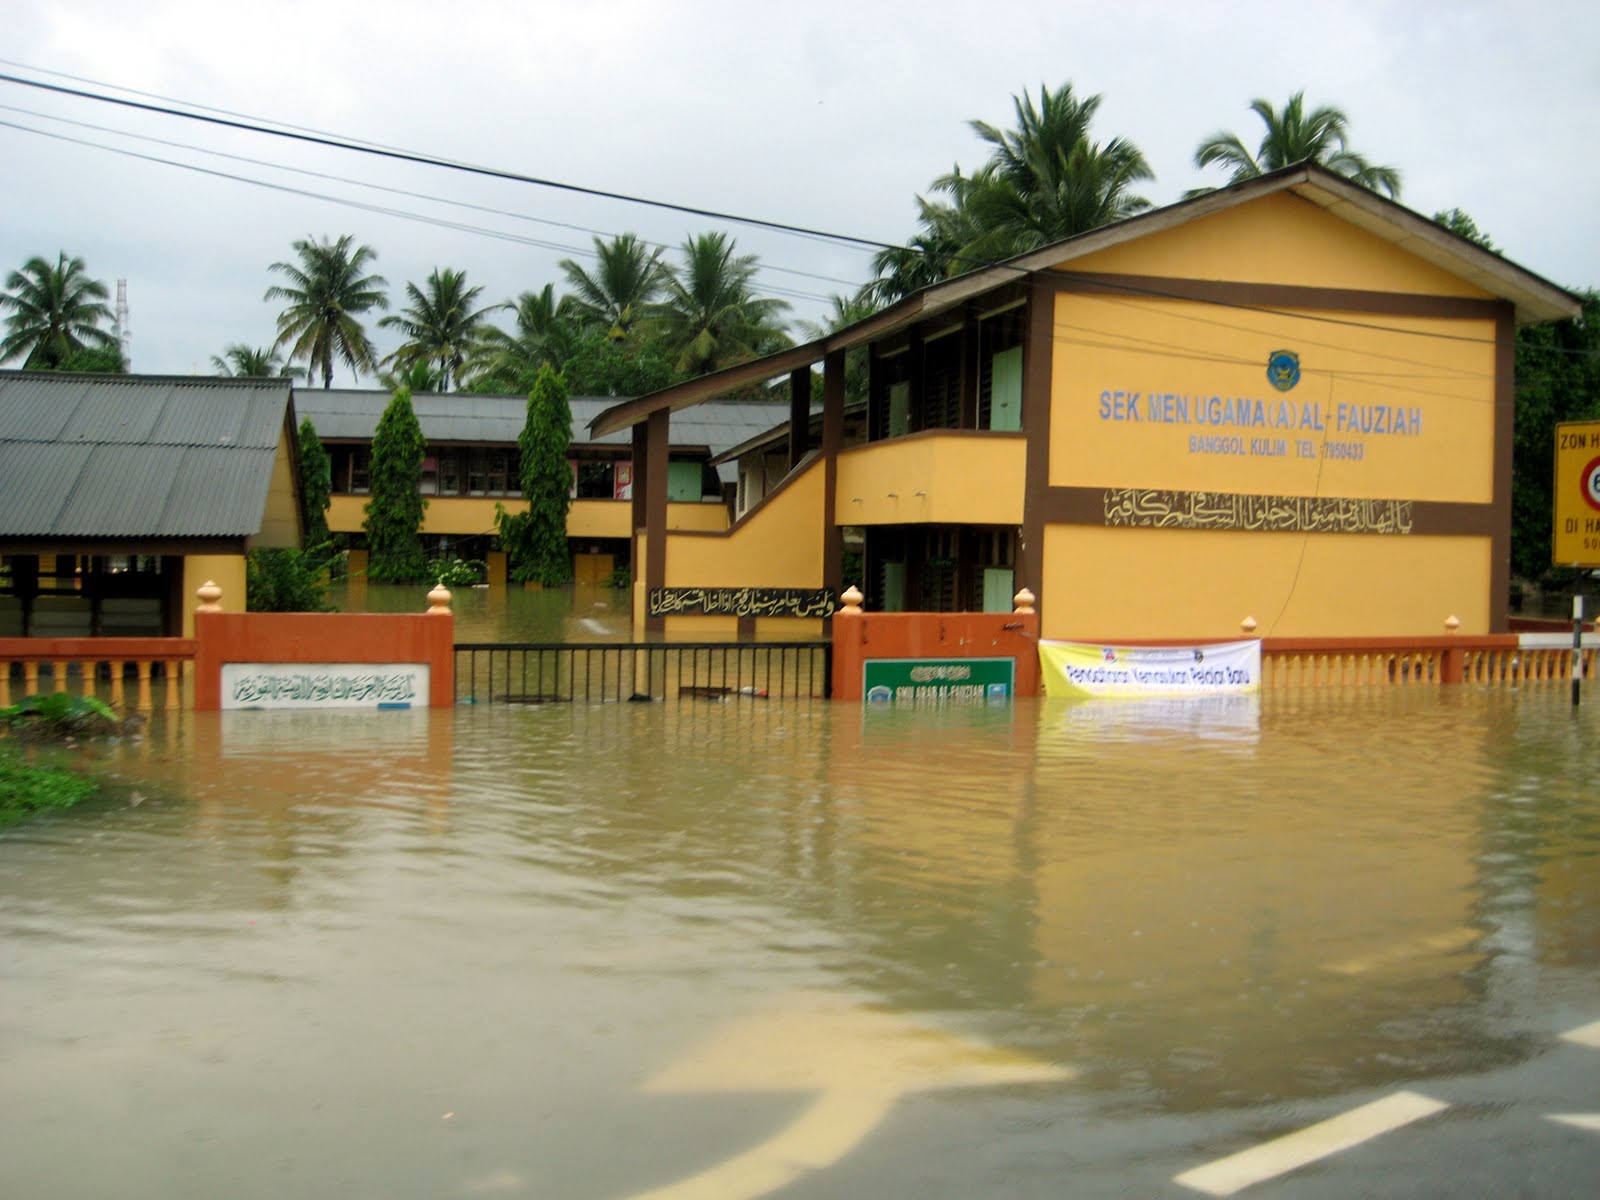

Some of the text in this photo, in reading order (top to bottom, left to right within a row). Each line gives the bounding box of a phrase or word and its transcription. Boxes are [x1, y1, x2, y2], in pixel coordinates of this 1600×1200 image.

[1188, 434, 1247, 456] BANGGOL
[1250, 437, 1287, 457] KULIM
[1560, 433, 1587, 449] ZON
[1565, 518, 1579, 534] DI
